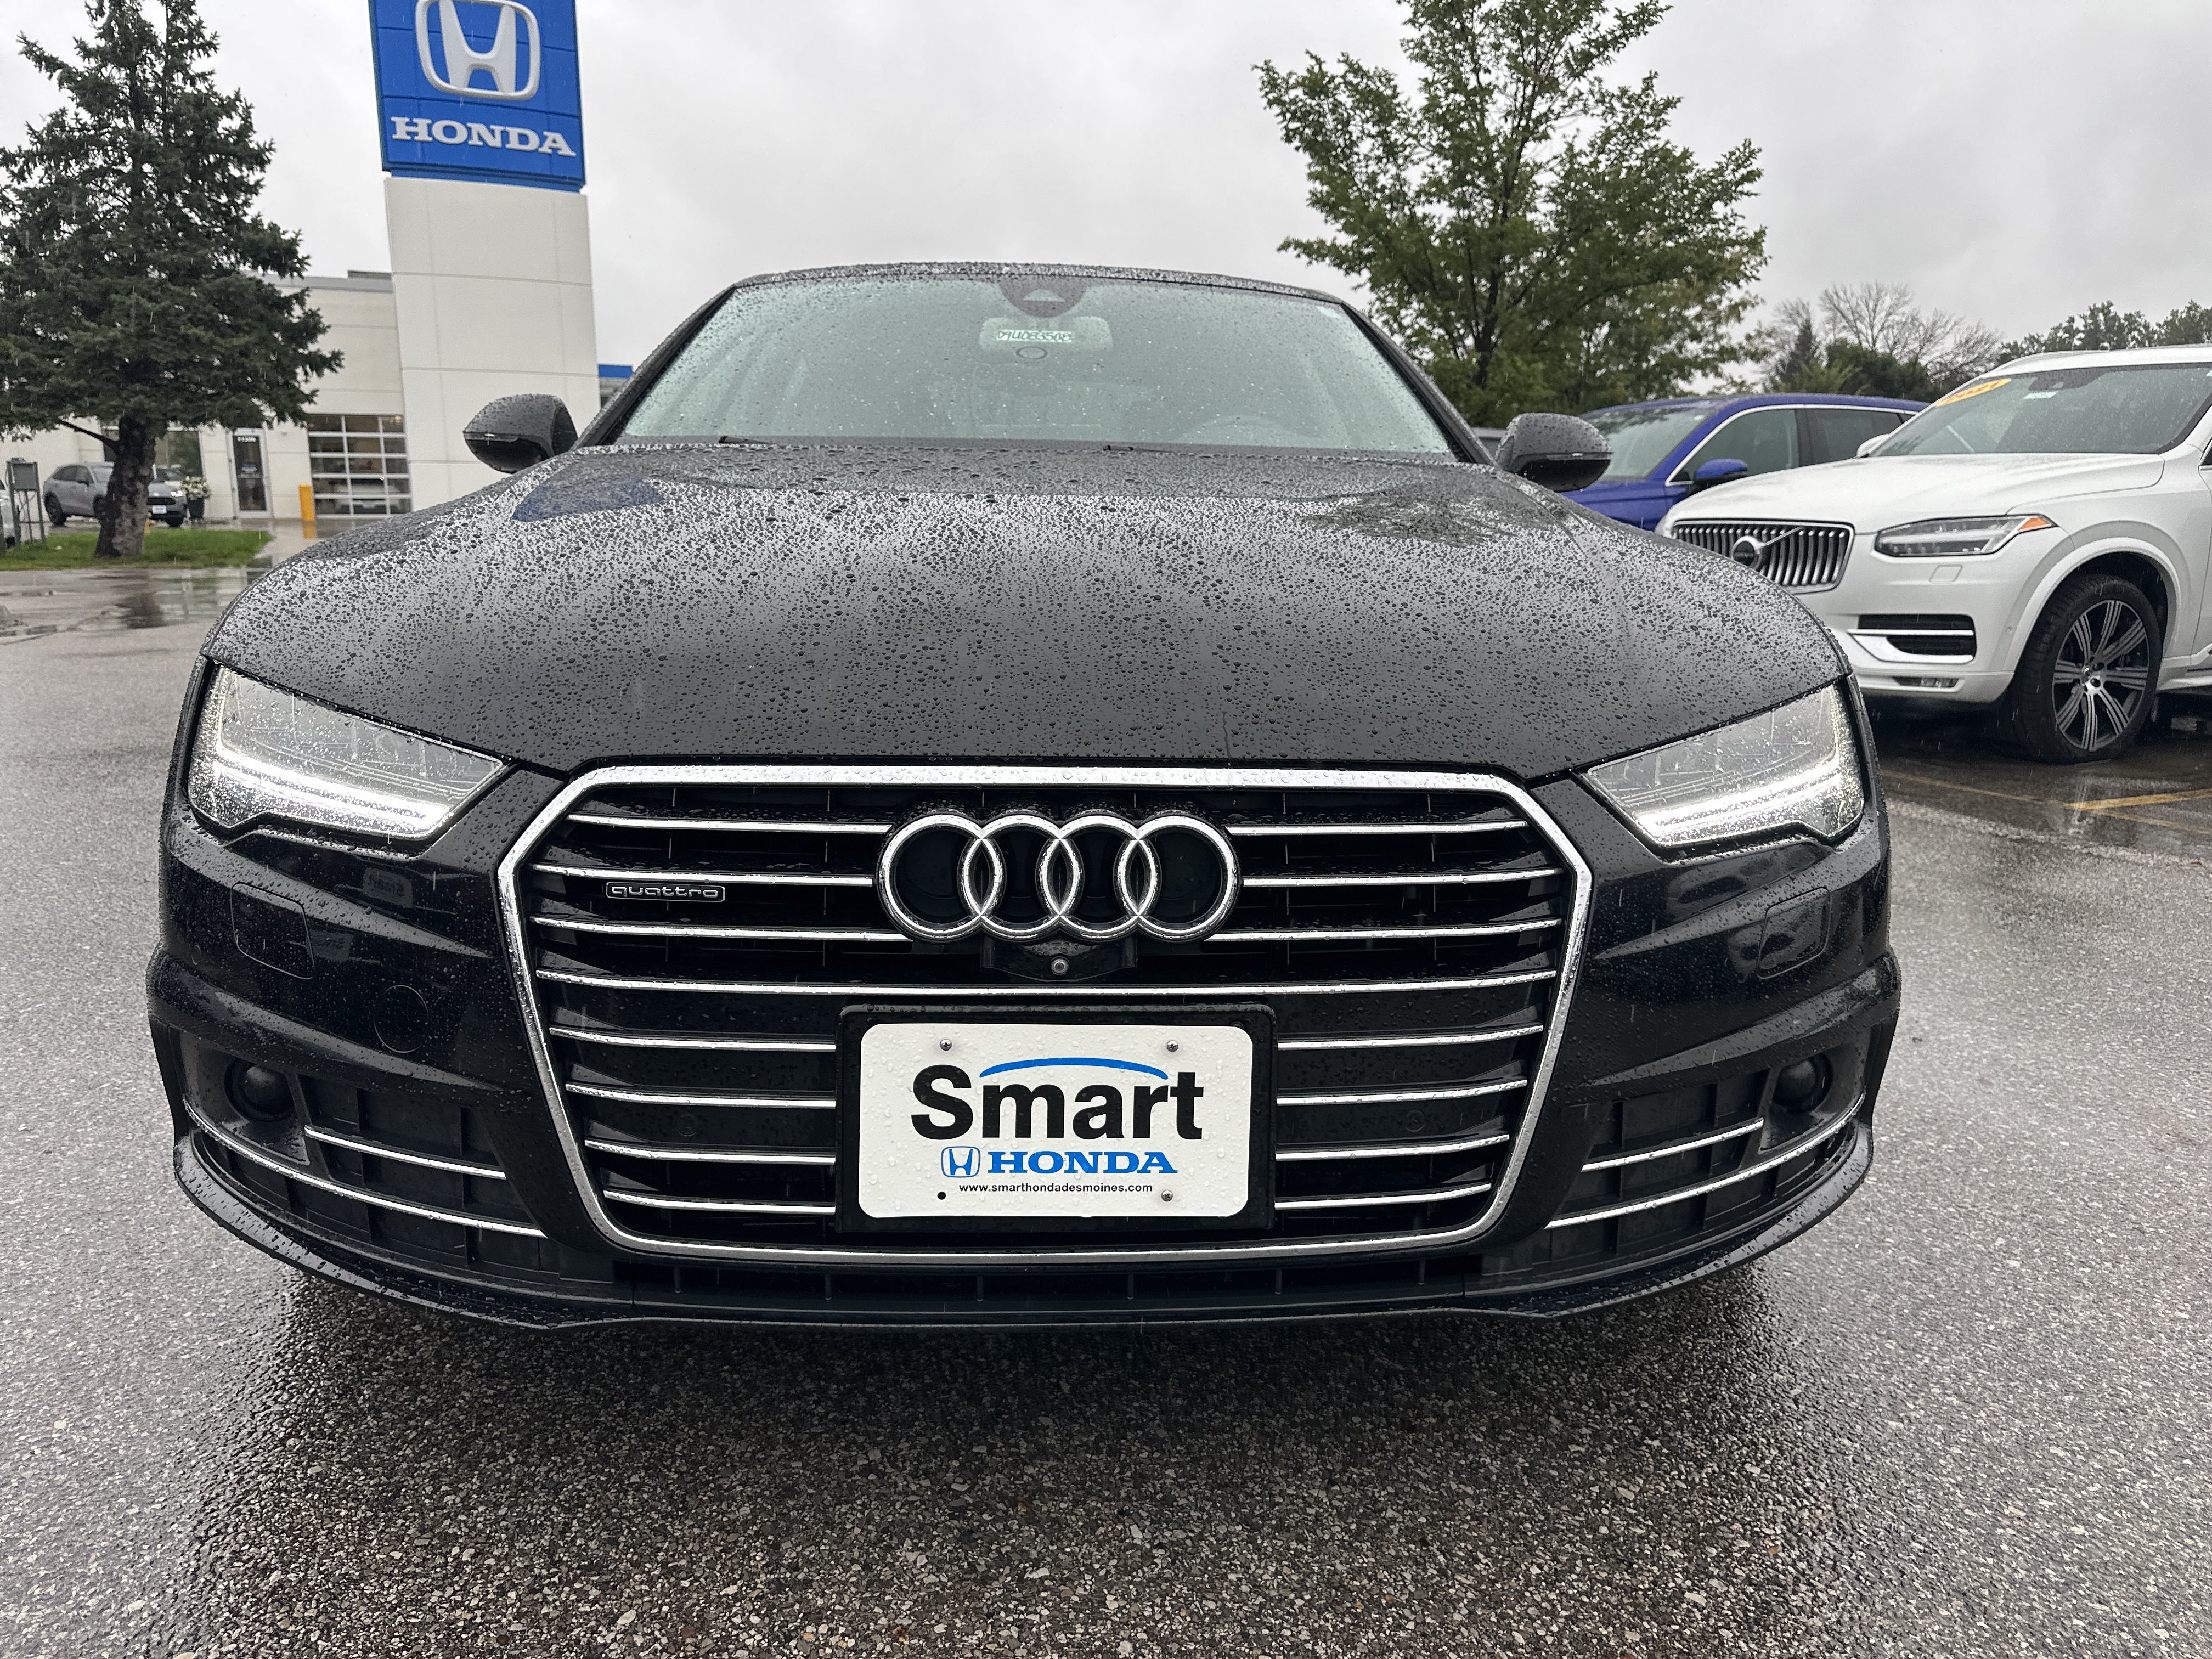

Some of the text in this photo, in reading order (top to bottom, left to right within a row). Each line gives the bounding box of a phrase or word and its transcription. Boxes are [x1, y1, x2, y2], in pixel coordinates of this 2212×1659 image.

[391, 117, 576, 156] HONDA
[611, 886, 719, 898] quattro
[911, 1064, 1204, 1139] Smart
[988, 1151, 1178, 1174] HONDA
[959, 1183, 1153, 1192] www.smarthondadesmoines.com
